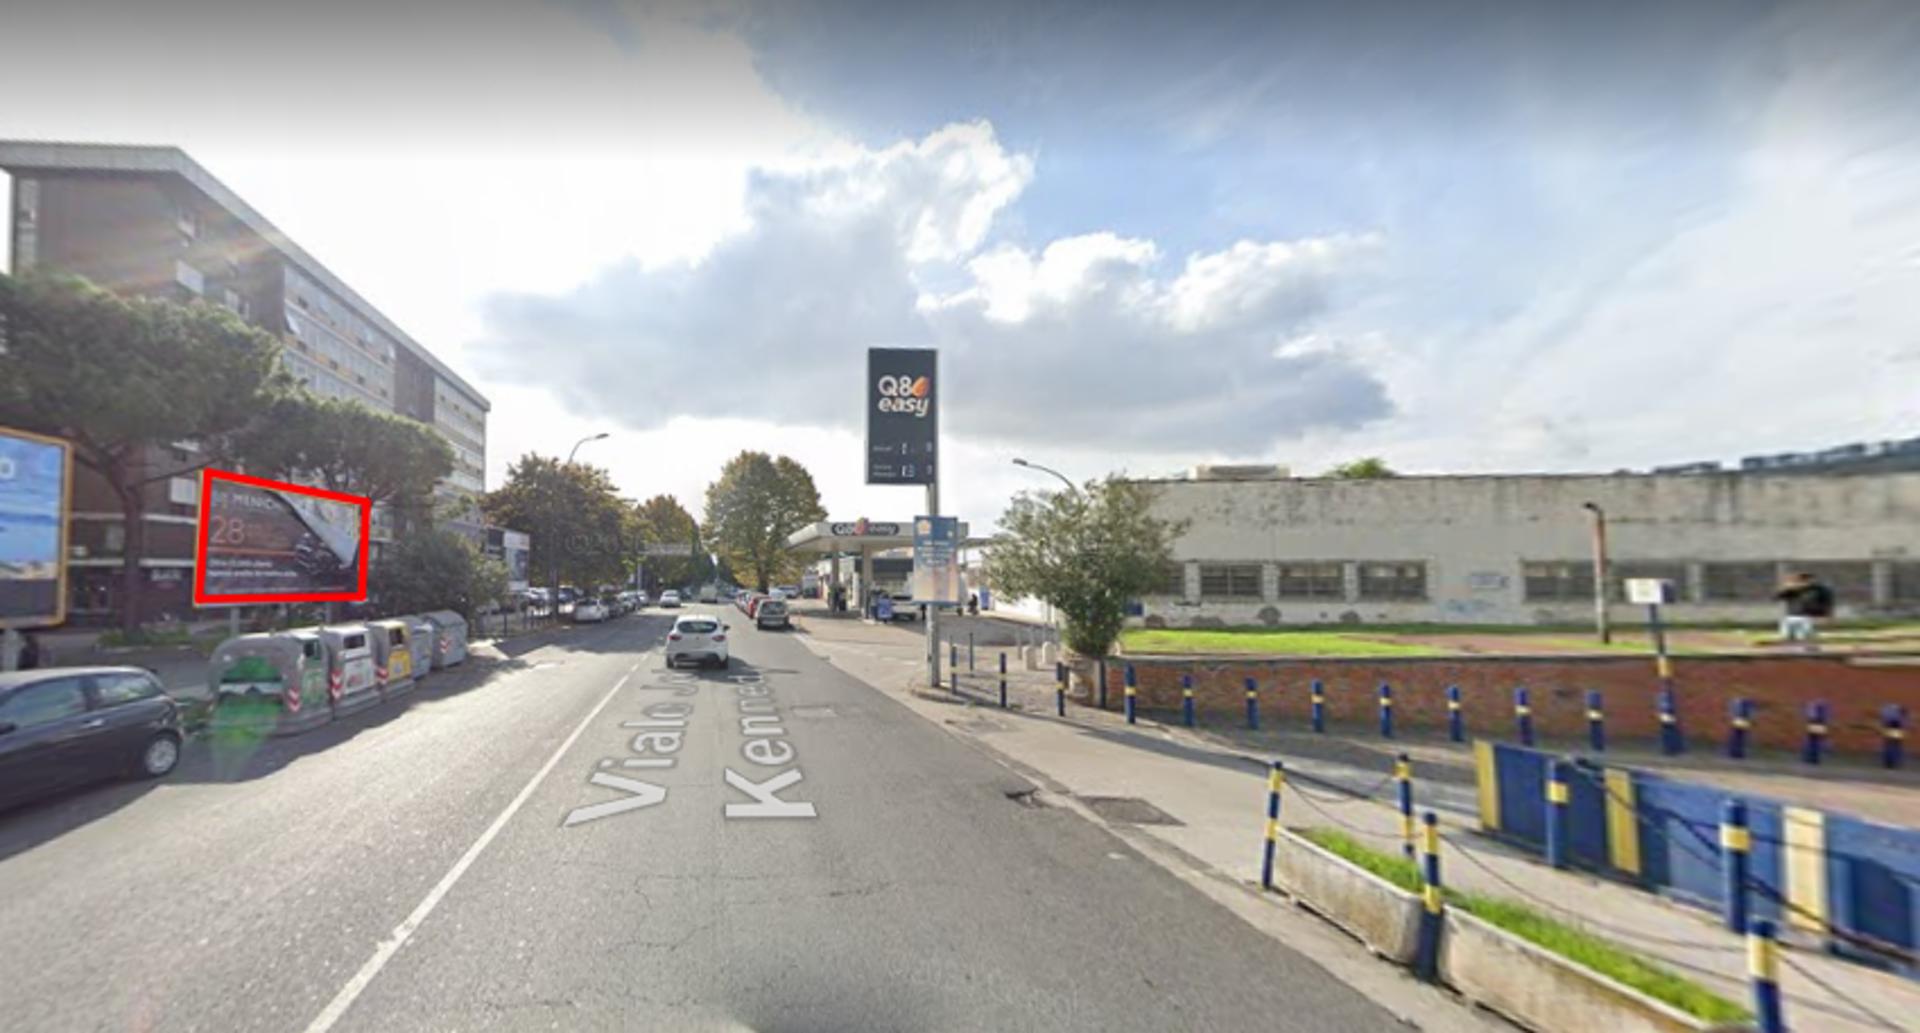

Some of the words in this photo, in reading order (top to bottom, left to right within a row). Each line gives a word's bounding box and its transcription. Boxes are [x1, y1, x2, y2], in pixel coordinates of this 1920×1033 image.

[878, 375, 912, 396] Q8
[878, 397, 930, 417] easy
[210, 515, 245, 544] 28
